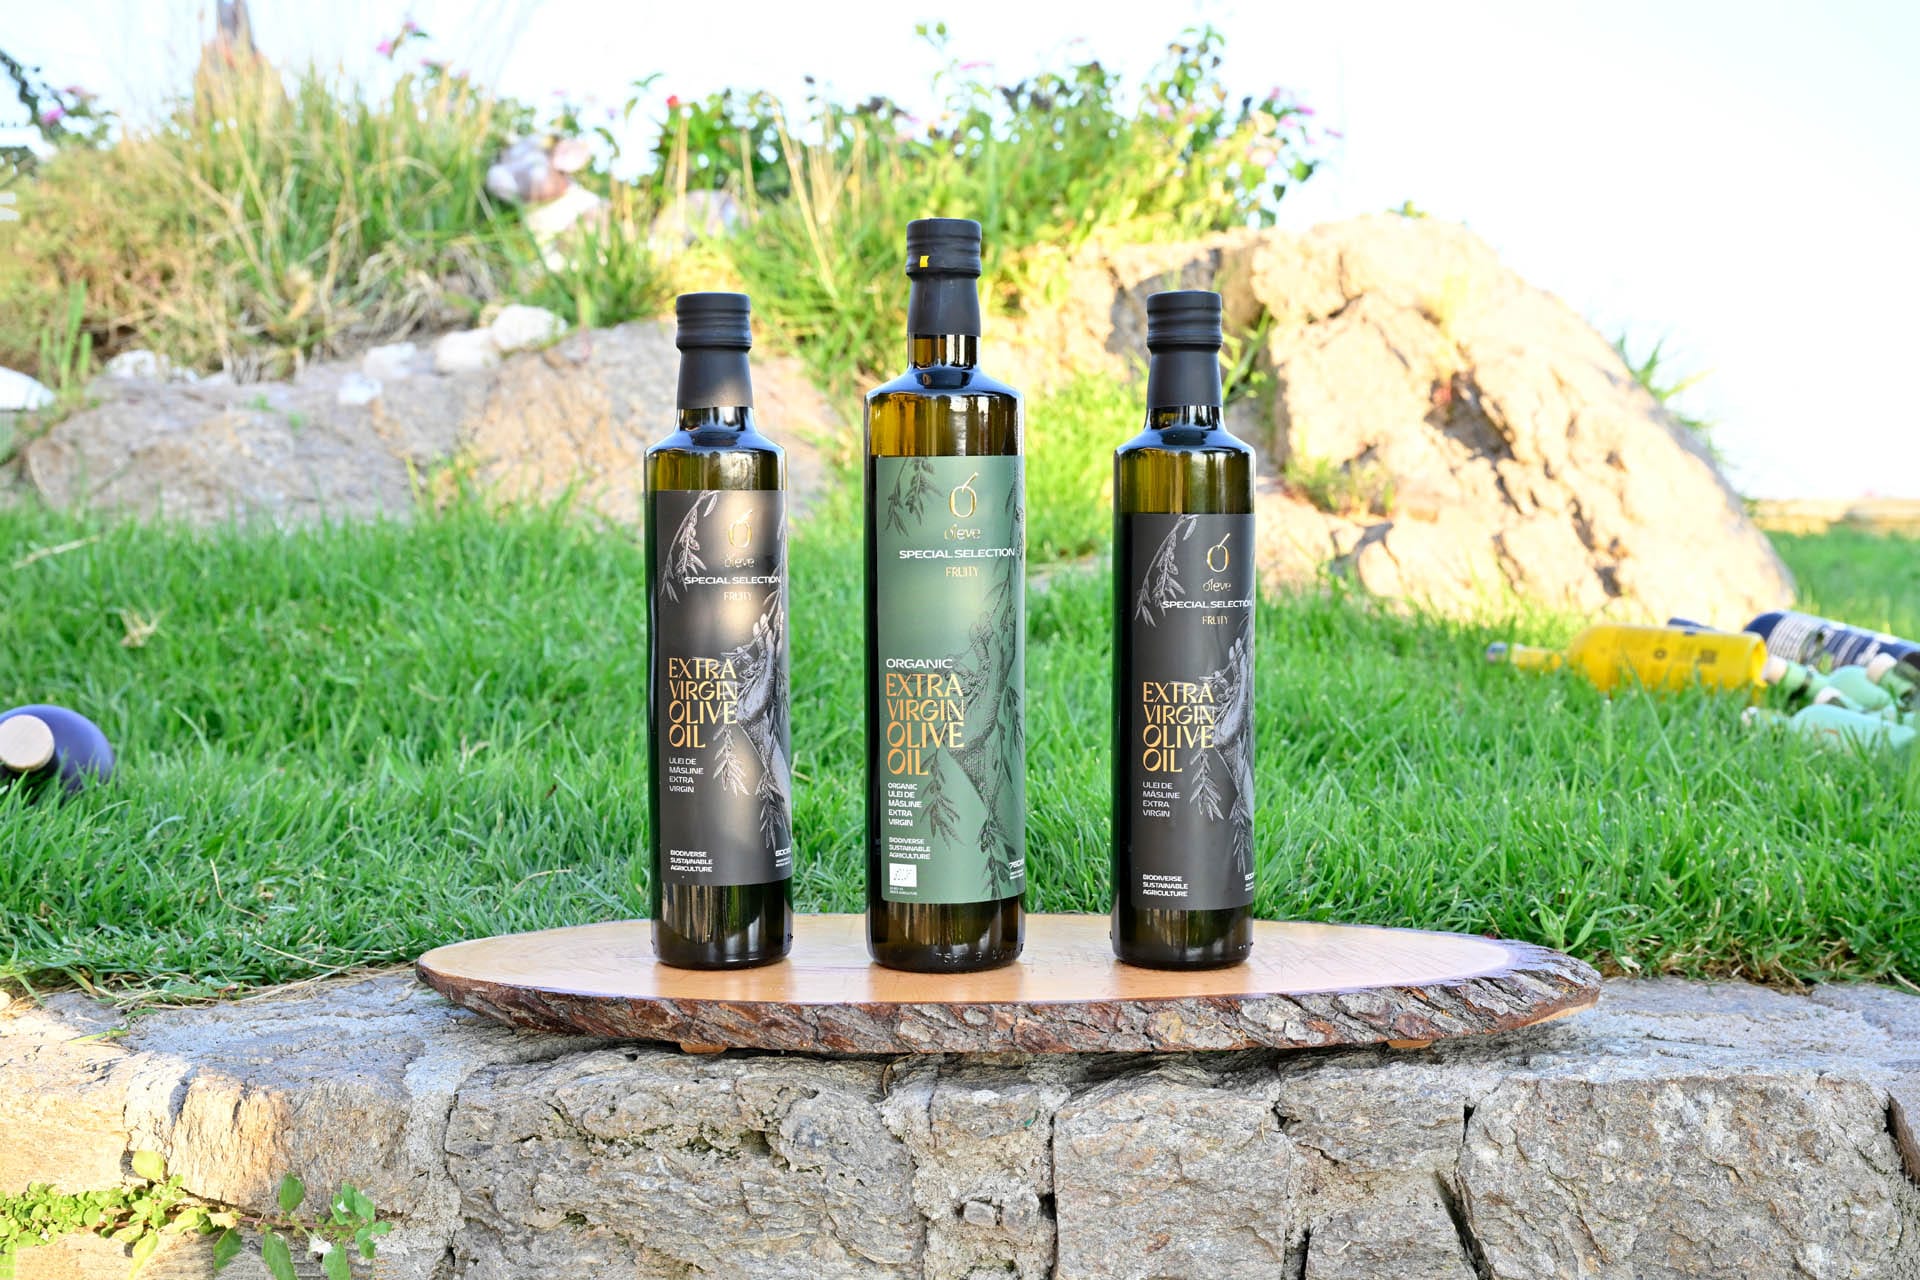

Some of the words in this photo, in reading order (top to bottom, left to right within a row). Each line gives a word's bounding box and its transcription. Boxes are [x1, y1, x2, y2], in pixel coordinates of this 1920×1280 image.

[899, 550, 953, 559] SPECIAL
[954, 548, 1016, 558] SELECTION
[945, 566, 978, 577] FRUITY
[684, 576, 730, 585] SPECIAL
[732, 575, 781, 585] SELECTION
[724, 591, 752, 601] FRUITY
[1161, 601, 1209, 609] SPECIAL
[1202, 615, 1229, 625] FRUITY
[668, 657, 737, 679] EXTRA
[886, 658, 953, 669] ORGANIC
[885, 672, 964, 698] EXTRA
[669, 680, 738, 701] VIRGIN
[1143, 681, 1215, 704] EXTRA
[669, 699, 738, 725] OLIVE
[886, 698, 964, 722] VIRGIN
[1143, 704, 1216, 725] VIRGIN
[669, 723, 706, 749] OIL
[886, 721, 965, 749] OLIVE
[1143, 724, 1216, 749] OLIVE
[669, 757, 685, 765] ULEI
[887, 748, 929, 776] OIL
[1143, 748, 1183, 773] OIL
[669, 775, 694, 784] EXTRA
[669, 785, 695, 793] VIRGIN
[888, 782, 918, 790] ORGANIC
[1142, 781, 1160, 789] ULEI
[1161, 782, 1174, 790] DE
[888, 790, 903, 798] ULEI
[904, 791, 916, 799] DE
[1142, 799, 1170, 808] EXTRA
[888, 808, 913, 817] EXTRA
[1142, 809, 1171, 817] VIRGIN
[888, 818, 914, 827] VIRGIN
[888, 836, 925, 845] BIODIVERSE
[888, 844, 931, 852] SUSTAINABLE
[670, 849, 707, 858] BIODIVERSE
[888, 852, 931, 860] AGRICULTURE
[670, 857, 713, 865] SUSTAINABLE
[670, 865, 713, 873] AGRICULTURE
[1142, 874, 1183, 882] BIODIVERSE
[1142, 881, 1189, 890] SUSTAINABLE
[1142, 889, 1189, 897] AGRICULTURE
